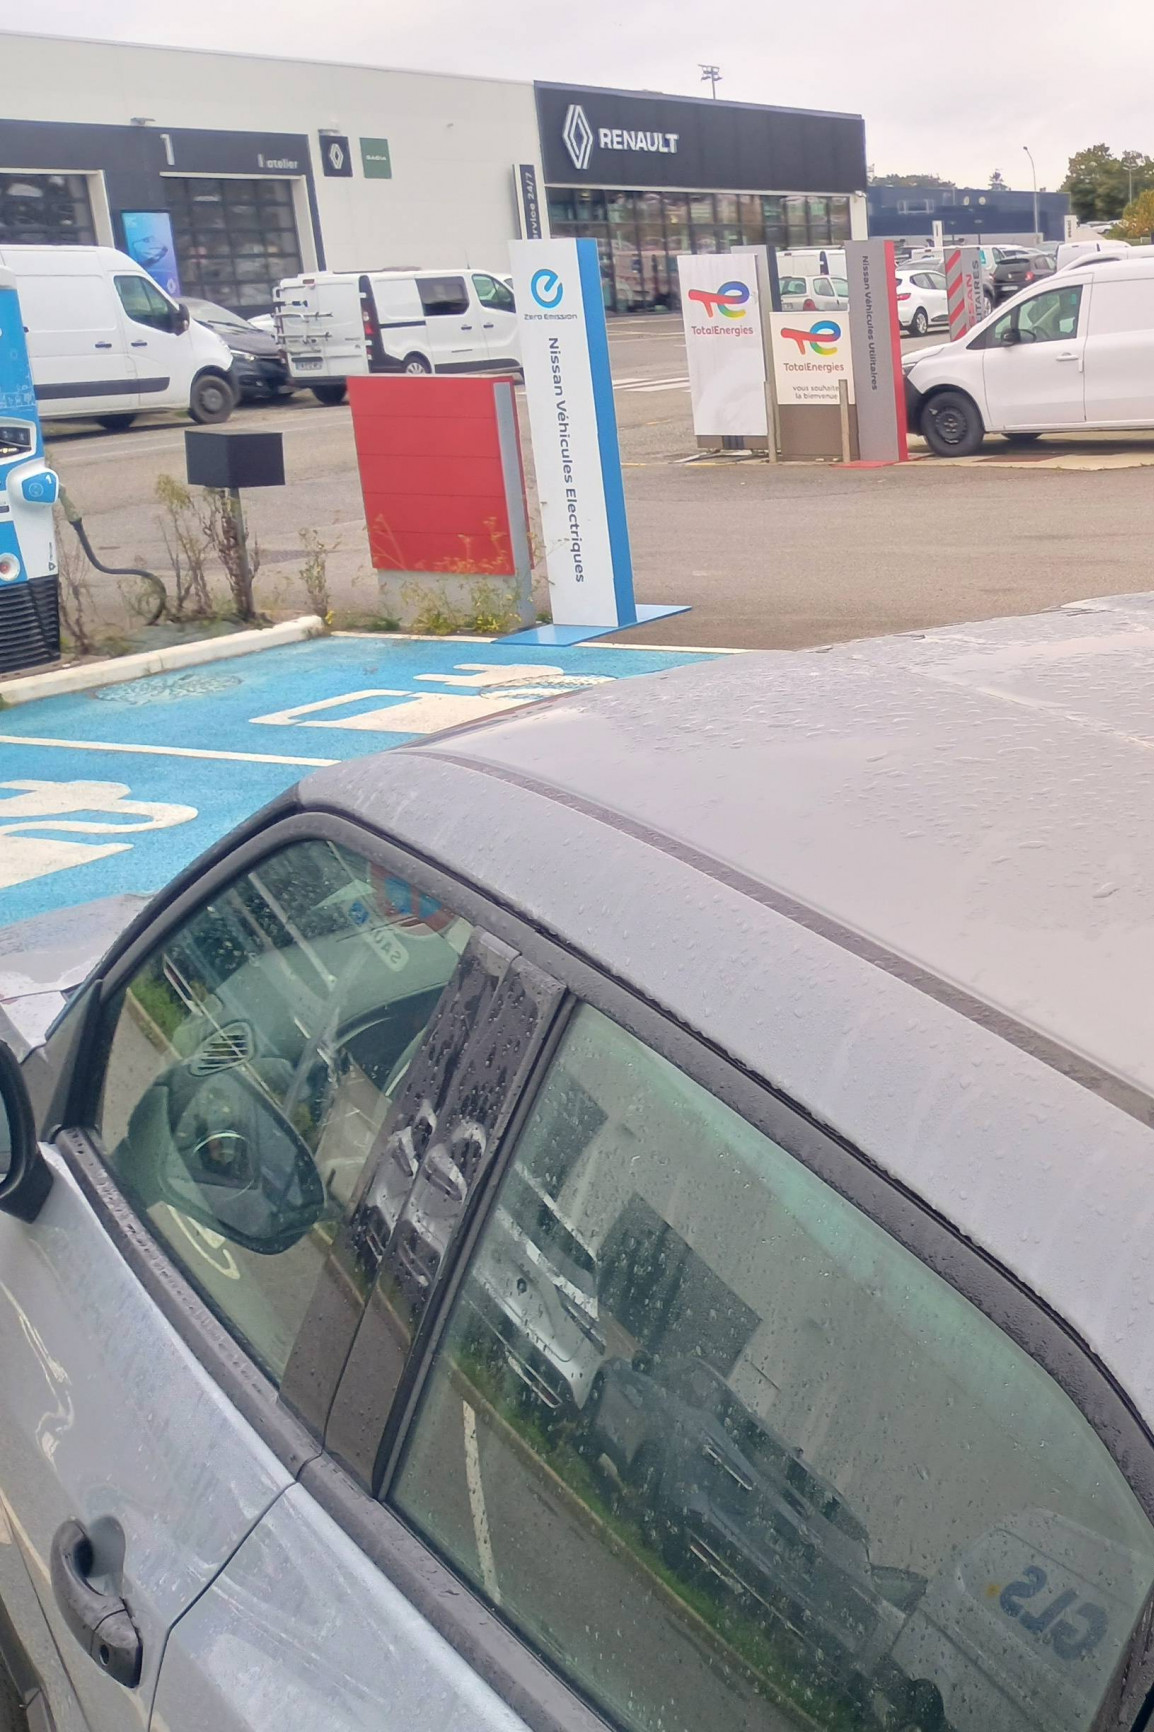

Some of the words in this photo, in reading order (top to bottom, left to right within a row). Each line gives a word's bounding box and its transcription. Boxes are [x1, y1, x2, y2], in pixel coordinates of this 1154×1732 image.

[598, 128, 680, 154] RENAULT
[525, 172, 535, 200] 24/7
[862, 255, 870, 290] Nissan
[691, 324, 754, 337] TotalEnergies
[864, 291, 874, 340] Véhicules
[783, 362, 845, 374] TotalEnergies
[868, 342, 878, 391] Utilitaires
[548, 337, 563, 397] Nissan
[556, 400, 574, 484] Véhicules
[566, 488, 585, 583] Electriques
